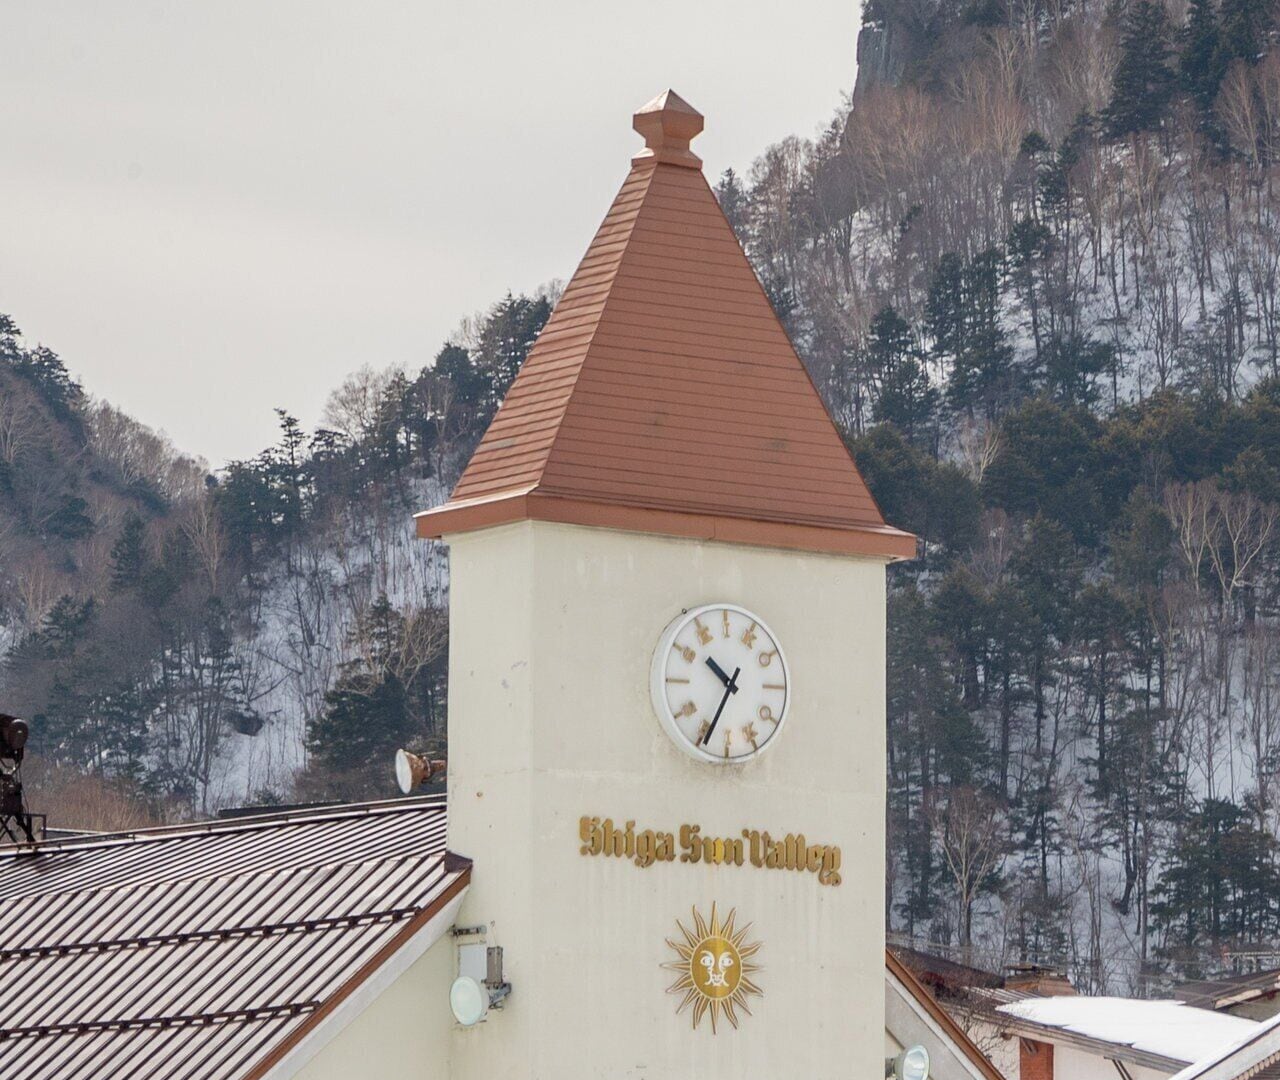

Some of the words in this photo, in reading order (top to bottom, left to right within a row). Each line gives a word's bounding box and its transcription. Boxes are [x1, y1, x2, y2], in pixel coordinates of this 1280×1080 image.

[579, 815, 676, 868] Shiga
[679, 824, 745, 867] Sun
[741, 828, 842, 887] Valley
